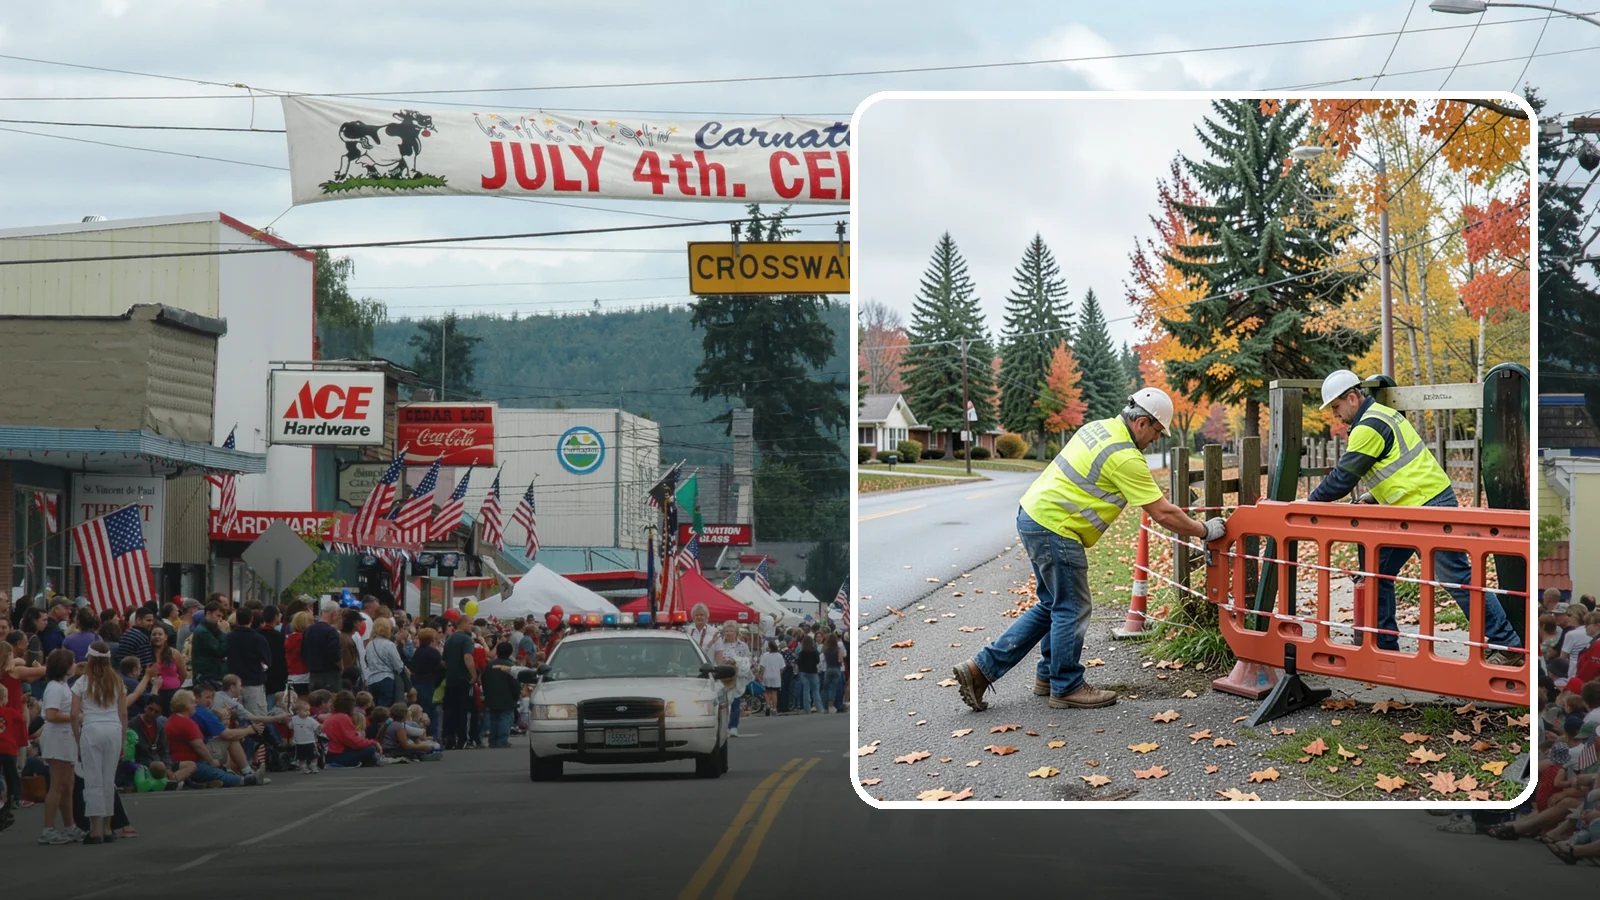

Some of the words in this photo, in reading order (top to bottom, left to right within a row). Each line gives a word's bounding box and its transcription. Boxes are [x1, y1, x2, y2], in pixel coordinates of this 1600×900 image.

[695, 121, 850, 149] Carnat
[481, 141, 605, 193] JULY
[632, 150, 746, 198] 4th.
[696, 254, 850, 279] CROSSWA
[283, 380, 373, 420] ACE
[406, 409, 453, 422] CEDAR
[283, 421, 371, 436] Hardware
[416, 428, 477, 447] Coca-Cola
[353, 467, 389, 479] Simpl
[83, 485, 94, 494] St.
[96, 485, 124, 495] Vincent
[126, 486, 136, 495] de
[138, 486, 155, 495] Paul
[81, 503, 154, 521] THT
[688, 526, 741, 535] CRNATION
[699, 535, 730, 543] GLASS
